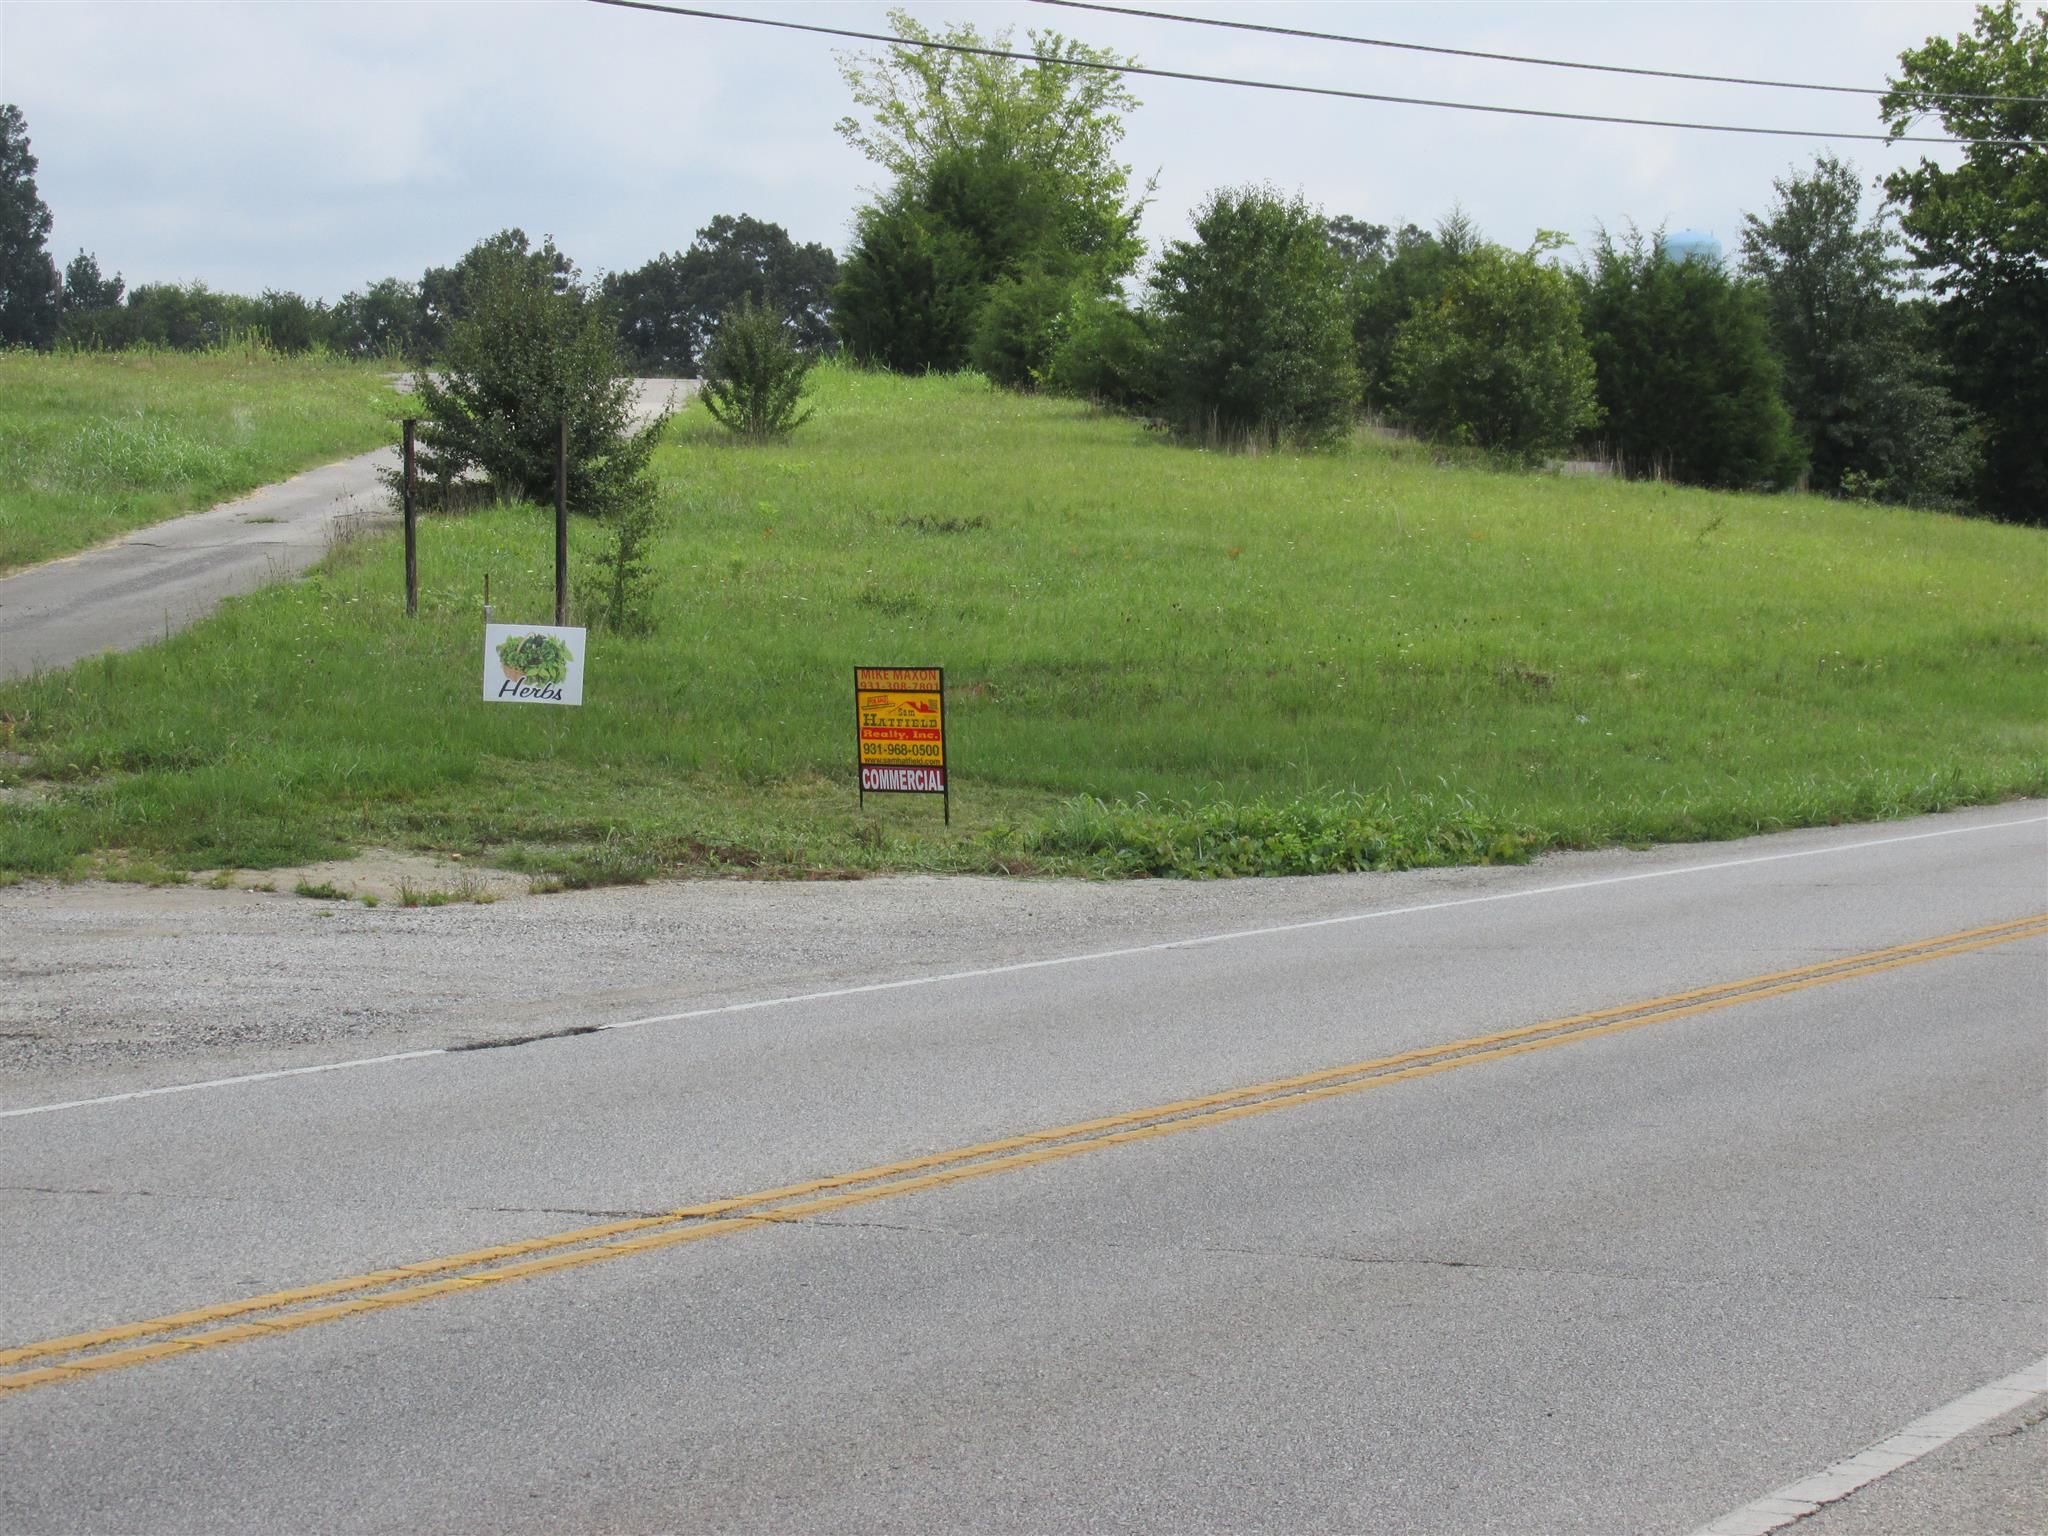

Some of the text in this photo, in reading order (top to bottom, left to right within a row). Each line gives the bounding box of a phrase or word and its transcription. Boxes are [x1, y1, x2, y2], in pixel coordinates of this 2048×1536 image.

[861, 670, 937, 681] MIKE MAXON
[498, 677, 562, 700] Herbs
[912, 731, 939, 739] Inc.
[863, 743, 939, 756] 931-968-0500
[862, 768, 944, 791] COMMERCIAL
